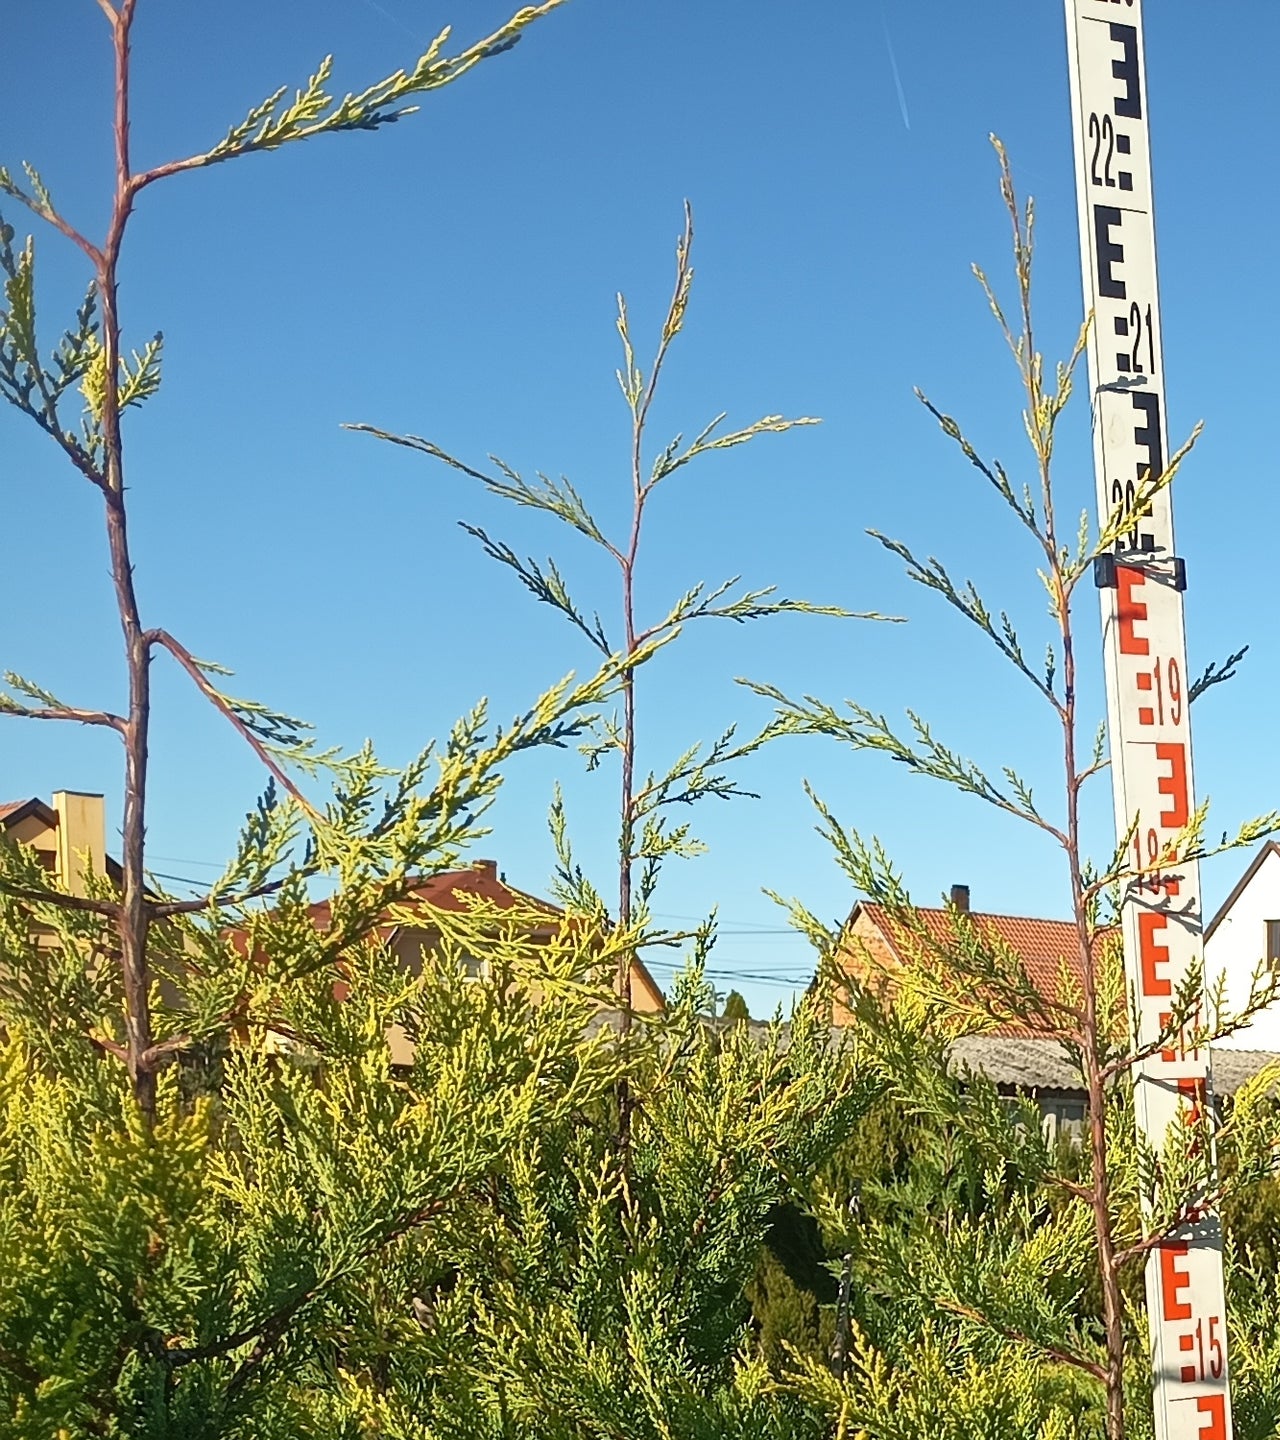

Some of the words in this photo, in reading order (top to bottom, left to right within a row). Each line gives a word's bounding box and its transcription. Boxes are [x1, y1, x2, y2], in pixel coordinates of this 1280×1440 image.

[1089, 112, 1116, 187] 22
[1130, 302, 1155, 374] 21
[1112, 478, 1139, 551] 20
[1154, 656, 1182, 726] 19
[1196, 1316, 1223, 1381] 15
